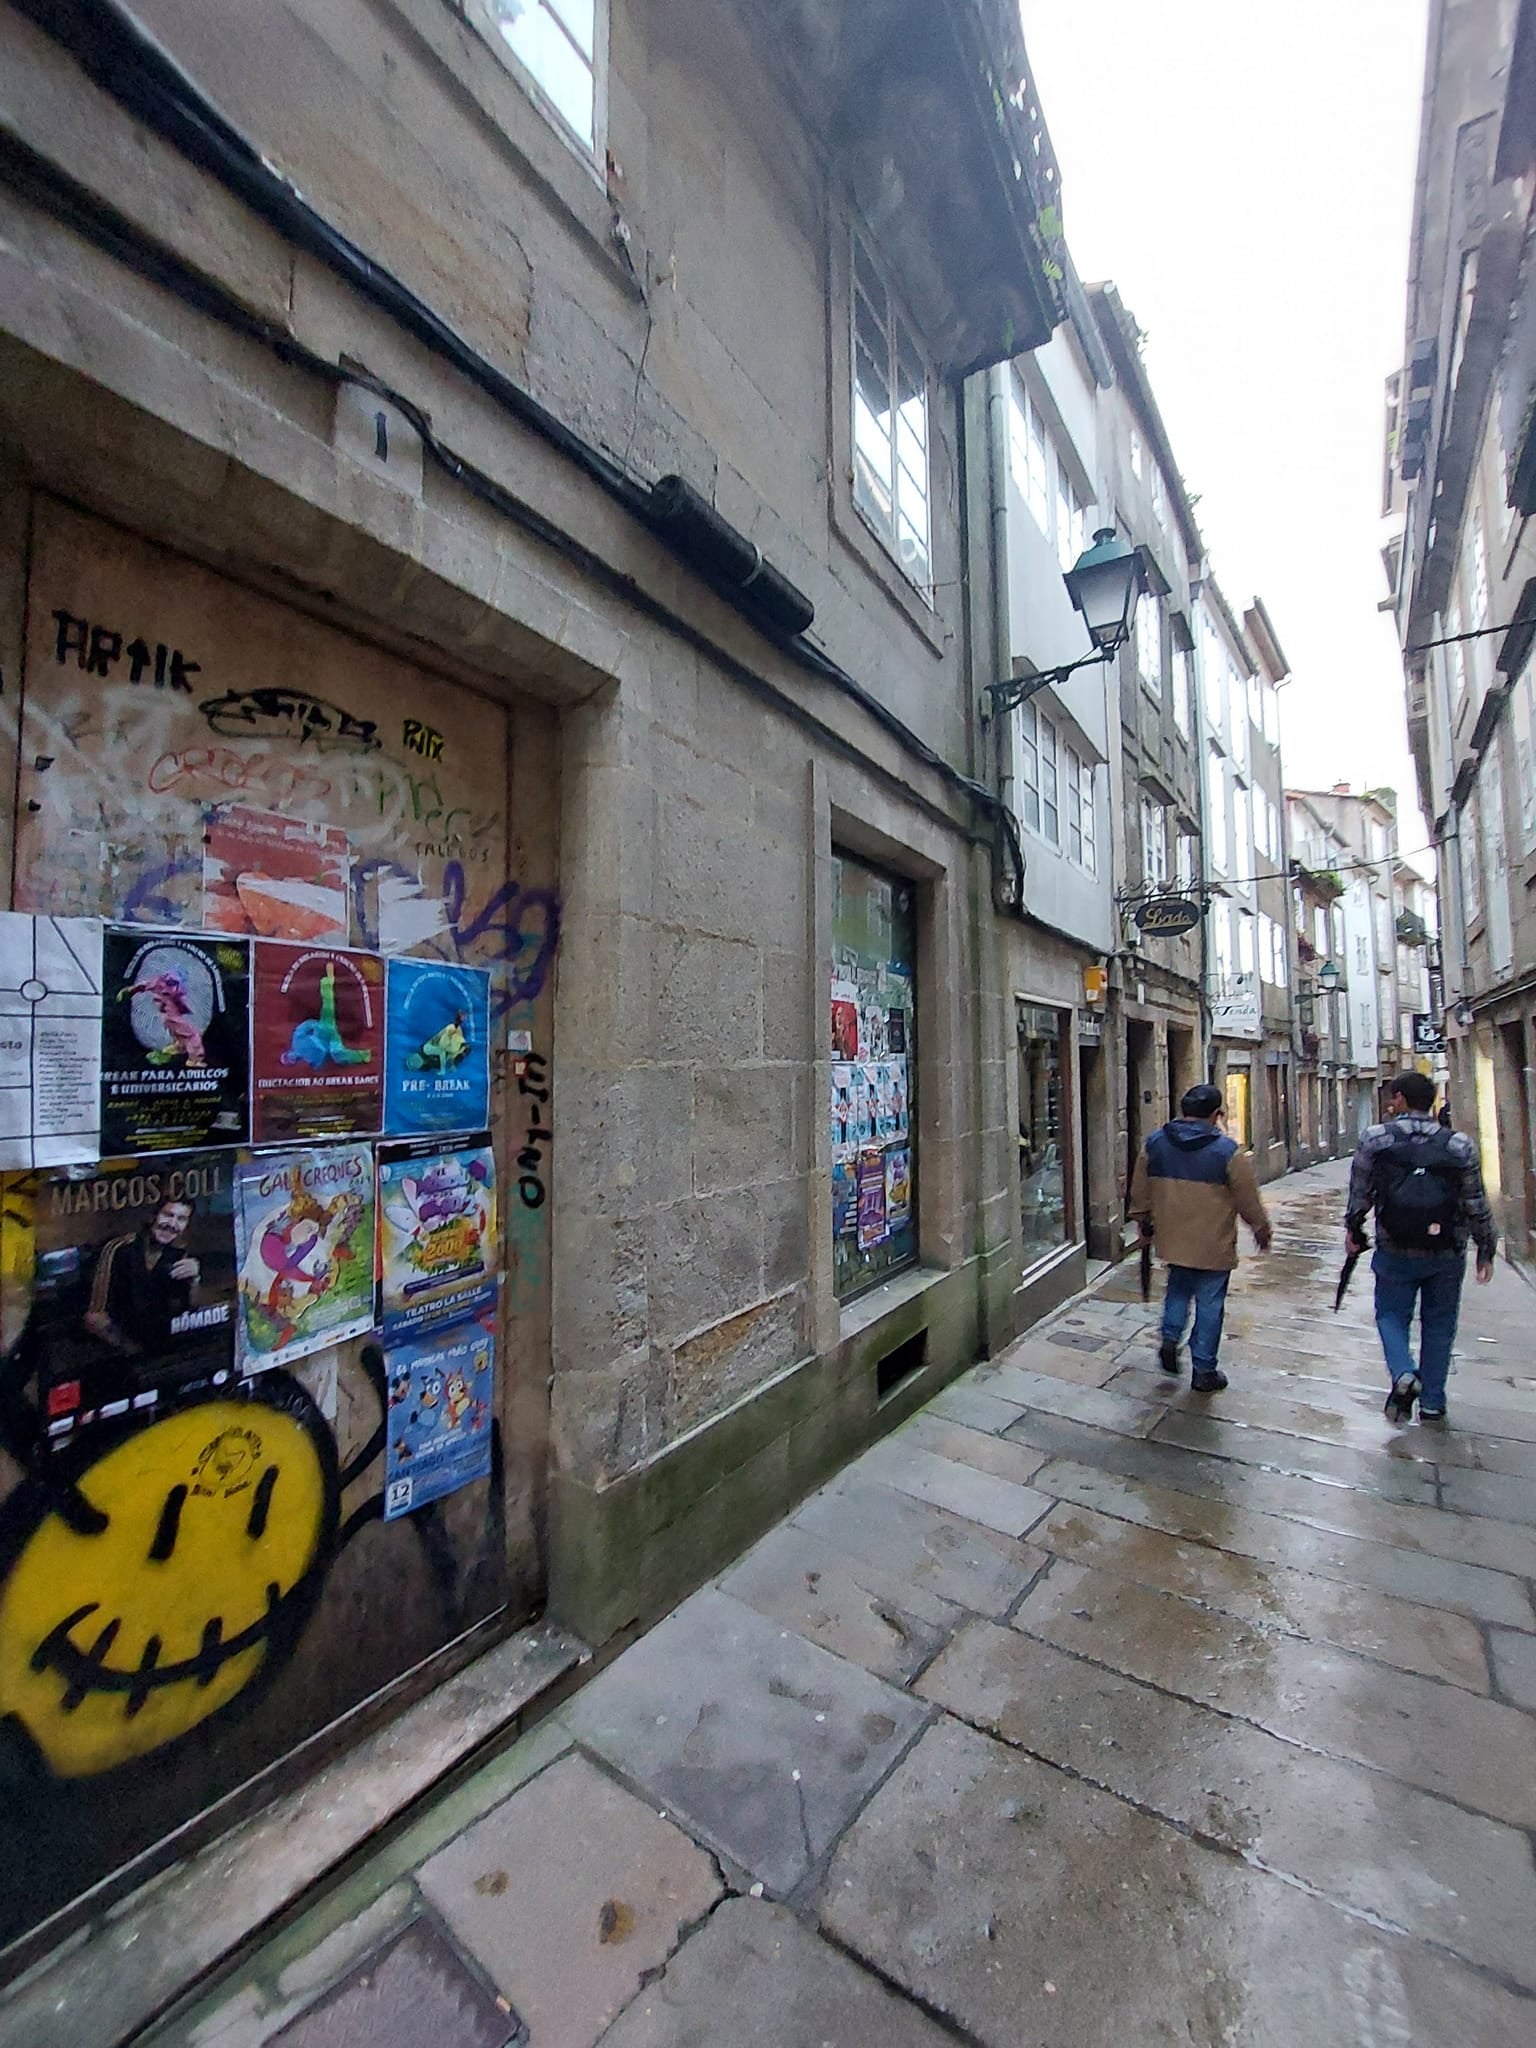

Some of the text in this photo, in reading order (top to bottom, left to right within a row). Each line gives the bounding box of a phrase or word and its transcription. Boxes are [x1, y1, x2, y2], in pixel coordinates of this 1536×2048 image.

[52, 1167, 224, 1216] MARCOS COLL
[405, 1300, 443, 1318] TEATRO
[444, 1295, 455, 1306] LA
[392, 1485, 409, 1501] 12
